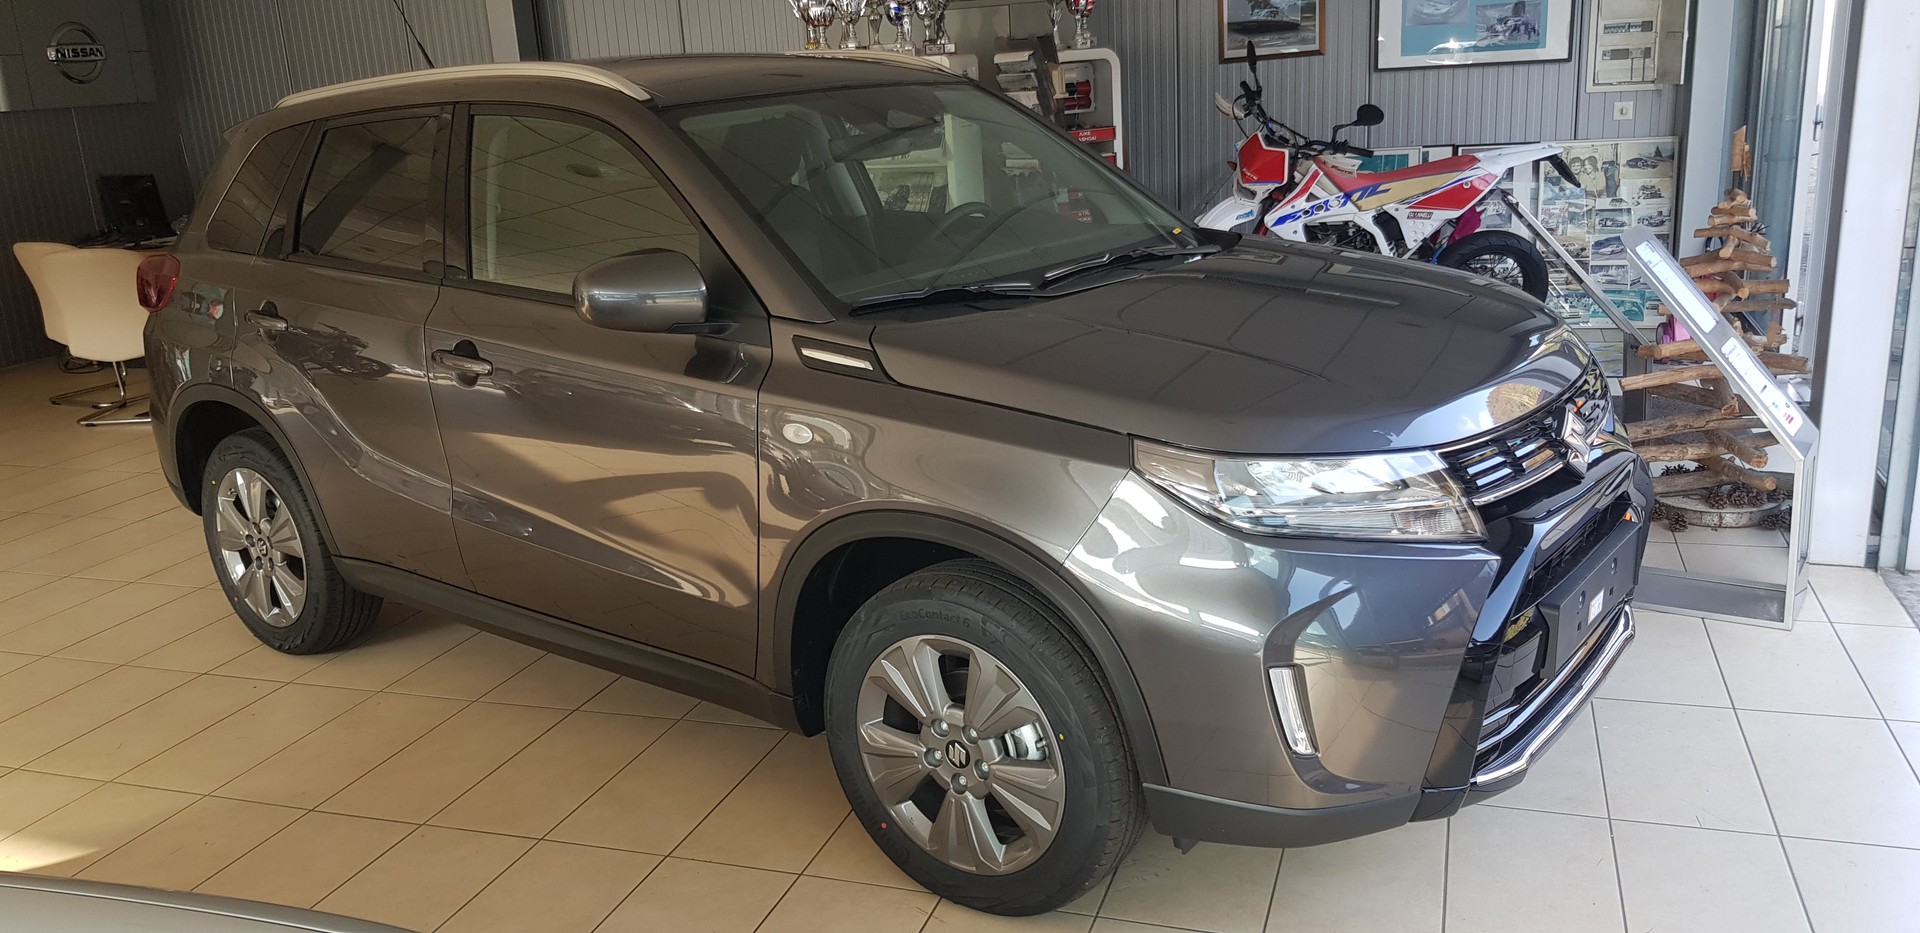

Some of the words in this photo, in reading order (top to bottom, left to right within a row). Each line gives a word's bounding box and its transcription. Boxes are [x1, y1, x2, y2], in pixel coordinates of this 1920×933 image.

[55, 47, 104, 59] NISSAN
[899, 608, 961, 625] EcoContact
[962, 617, 972, 628] 6
